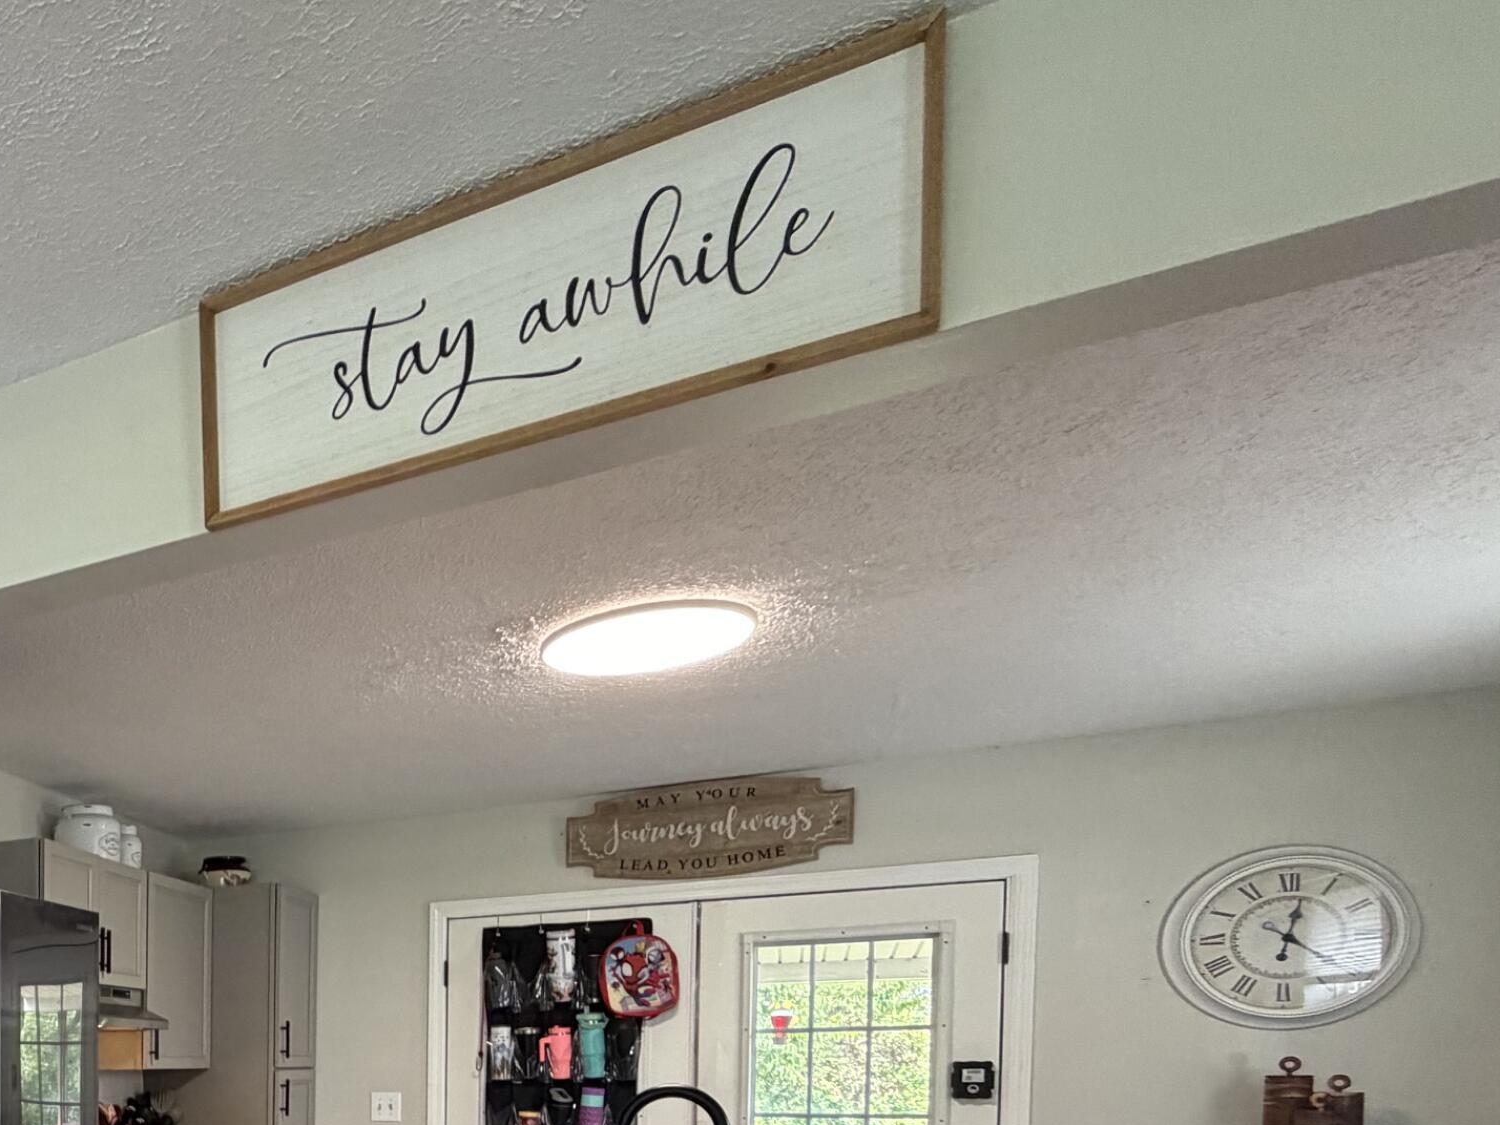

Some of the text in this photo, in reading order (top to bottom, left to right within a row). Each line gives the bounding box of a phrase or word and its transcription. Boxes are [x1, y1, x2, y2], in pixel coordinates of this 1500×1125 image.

[263, 143, 835, 435] stay awhile
[636, 787, 757, 809] MAY YOUR
[711, 806, 815, 840] always
[619, 845, 787, 872] LEAD YOU HOME
